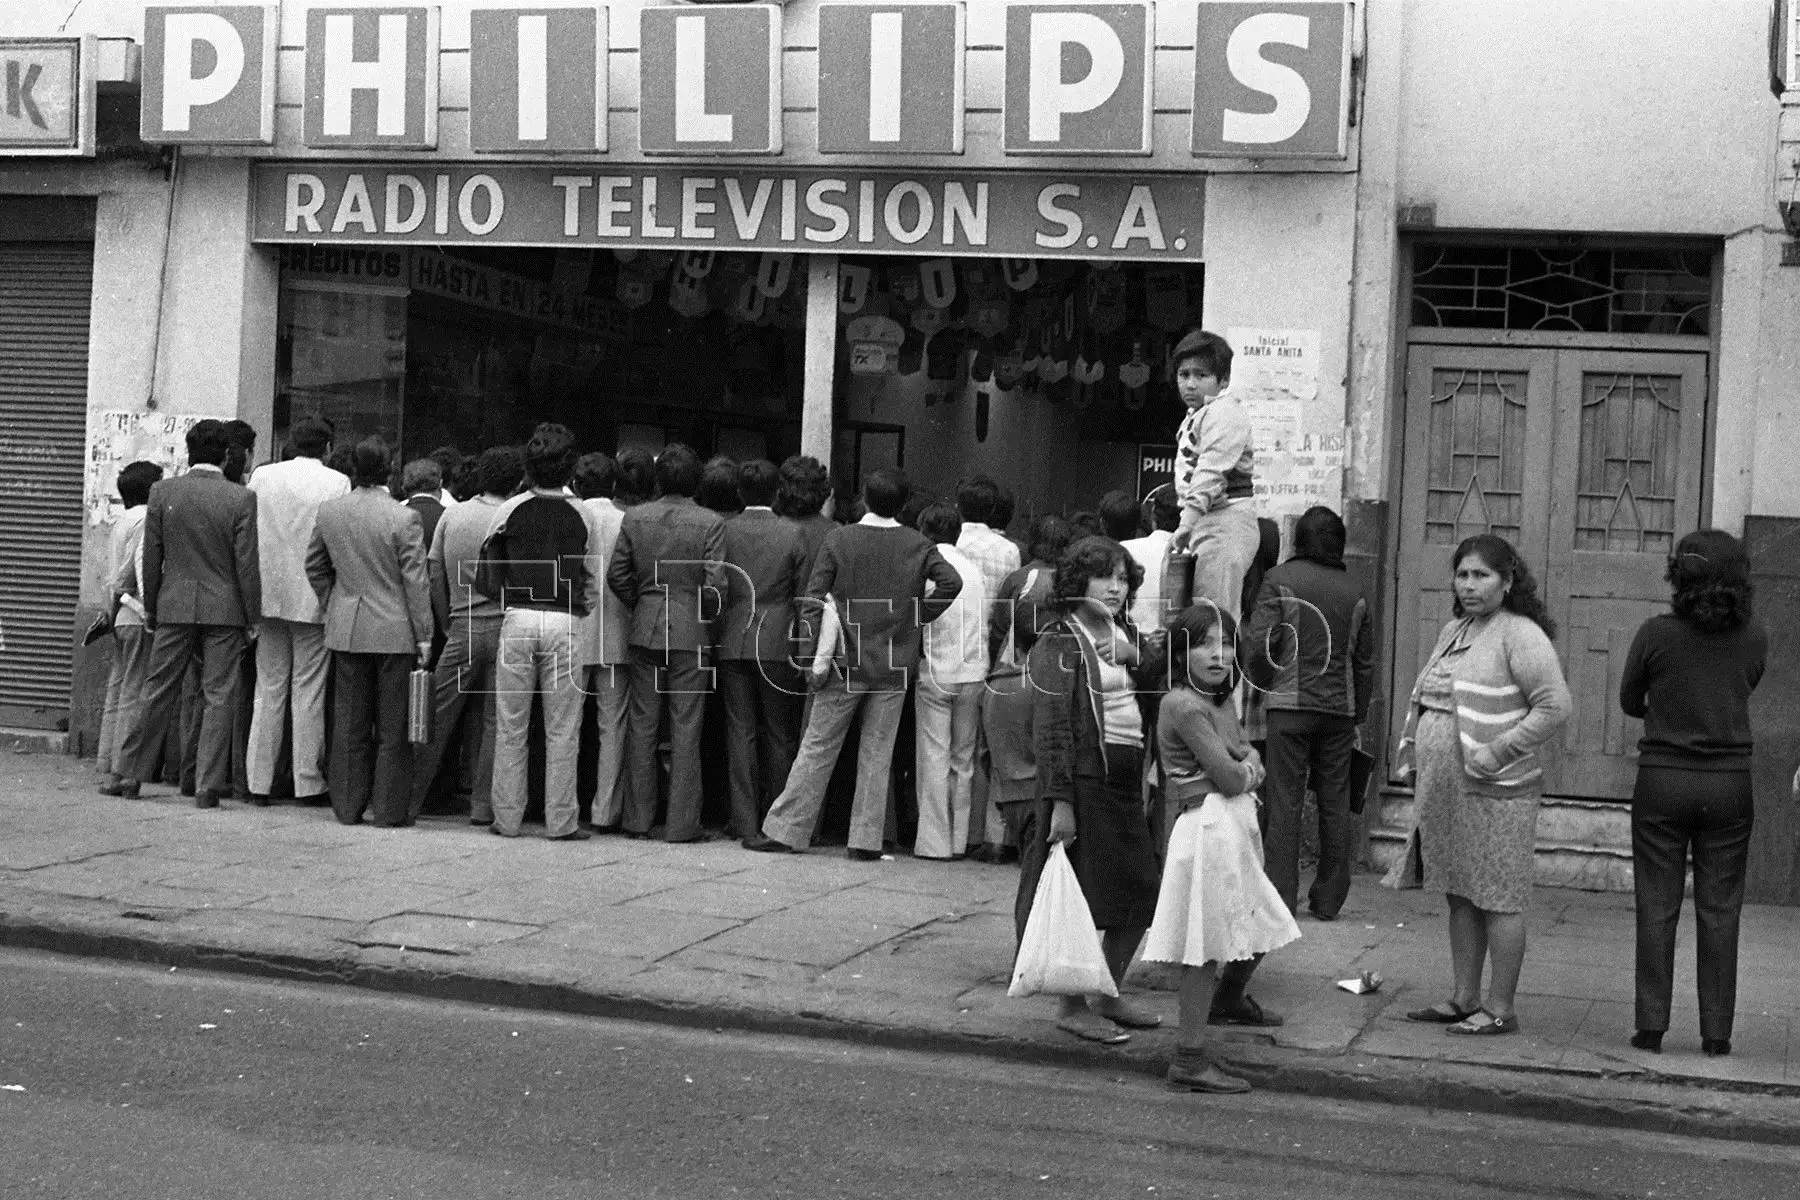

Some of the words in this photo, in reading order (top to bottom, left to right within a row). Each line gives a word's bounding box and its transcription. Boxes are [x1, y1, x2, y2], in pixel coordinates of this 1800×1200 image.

[161, 12, 1311, 145] PHILIPS
[284, 173, 505, 236] RADIO
[553, 175, 989, 246] TELEVISION
[1035, 183, 1188, 252] S.A.
[419, 256, 489, 301] HASTA
[1243, 345, 1272, 357] SANTA
[1277, 346, 1303, 358] ANITA
